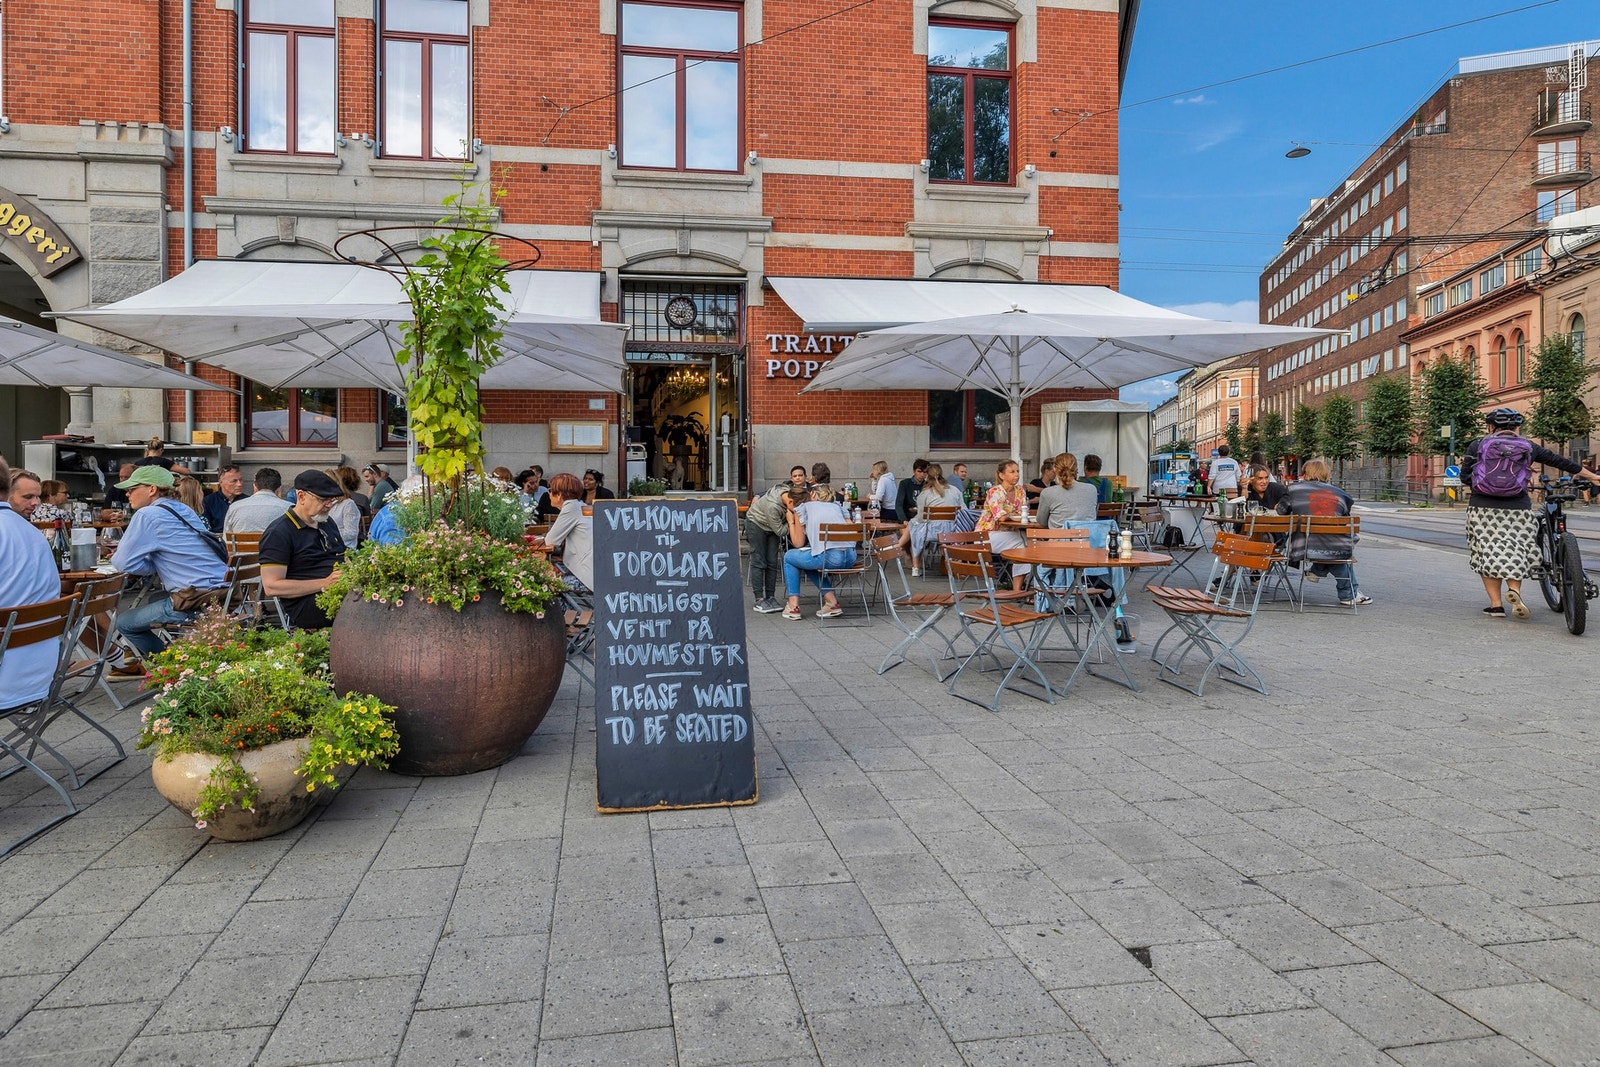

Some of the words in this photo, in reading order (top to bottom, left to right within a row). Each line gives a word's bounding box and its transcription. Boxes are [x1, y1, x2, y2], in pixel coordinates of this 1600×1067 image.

[765, 358, 832, 379] POP
[604, 505, 729, 533] VELKOMMEN
[613, 551, 730, 580] POPOLARE
[606, 618, 671, 640] VENT
[688, 616, 714, 640] PÅ
[607, 642, 744, 666] HOVMESTER
[610, 682, 682, 711] PLEASE
[605, 716, 635, 745] TO
[643, 714, 669, 745] BE
[675, 712, 748, 743] SEATED
